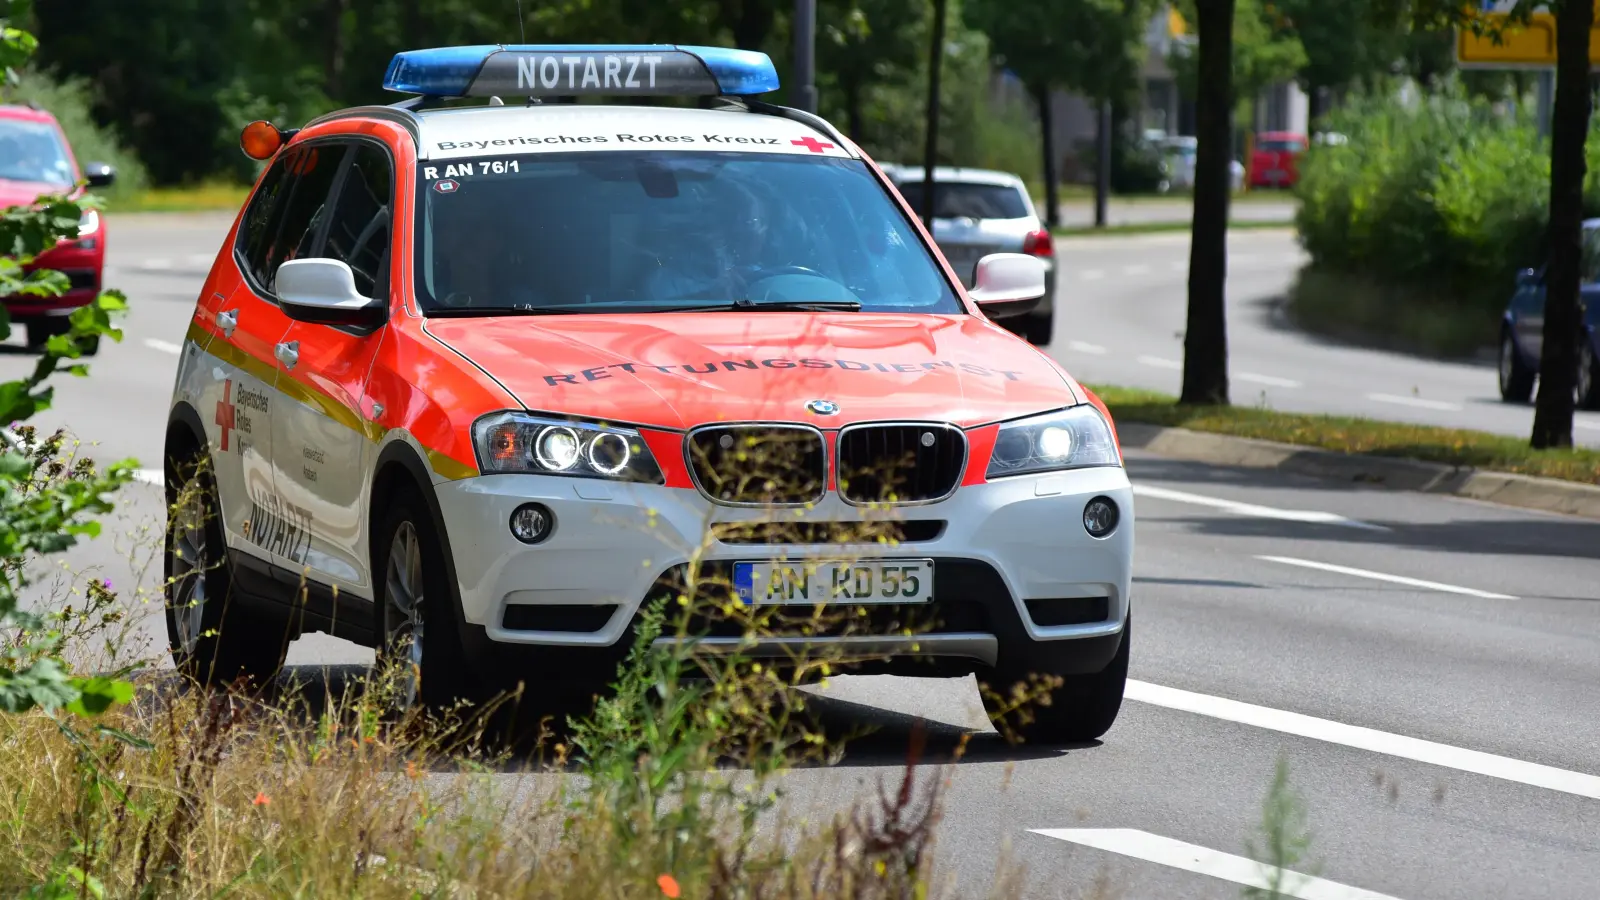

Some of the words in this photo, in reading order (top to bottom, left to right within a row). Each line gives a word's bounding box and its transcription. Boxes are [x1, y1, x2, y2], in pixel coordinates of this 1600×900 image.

[517, 55, 662, 89] NOTARZT
[437, 135, 608, 151] Bayerisches
[616, 133, 695, 144] Rotes
[702, 133, 782, 145] Kreuz
[424, 167, 439, 180] R
[445, 163, 474, 177] AN
[479, 160, 520, 175] 76/1
[543, 358, 1023, 386] RETTUNGSDIENST
[237, 383, 269, 413] Bayerisches
[236, 408, 252, 434] Rotes
[881, 566, 920, 598] 55
